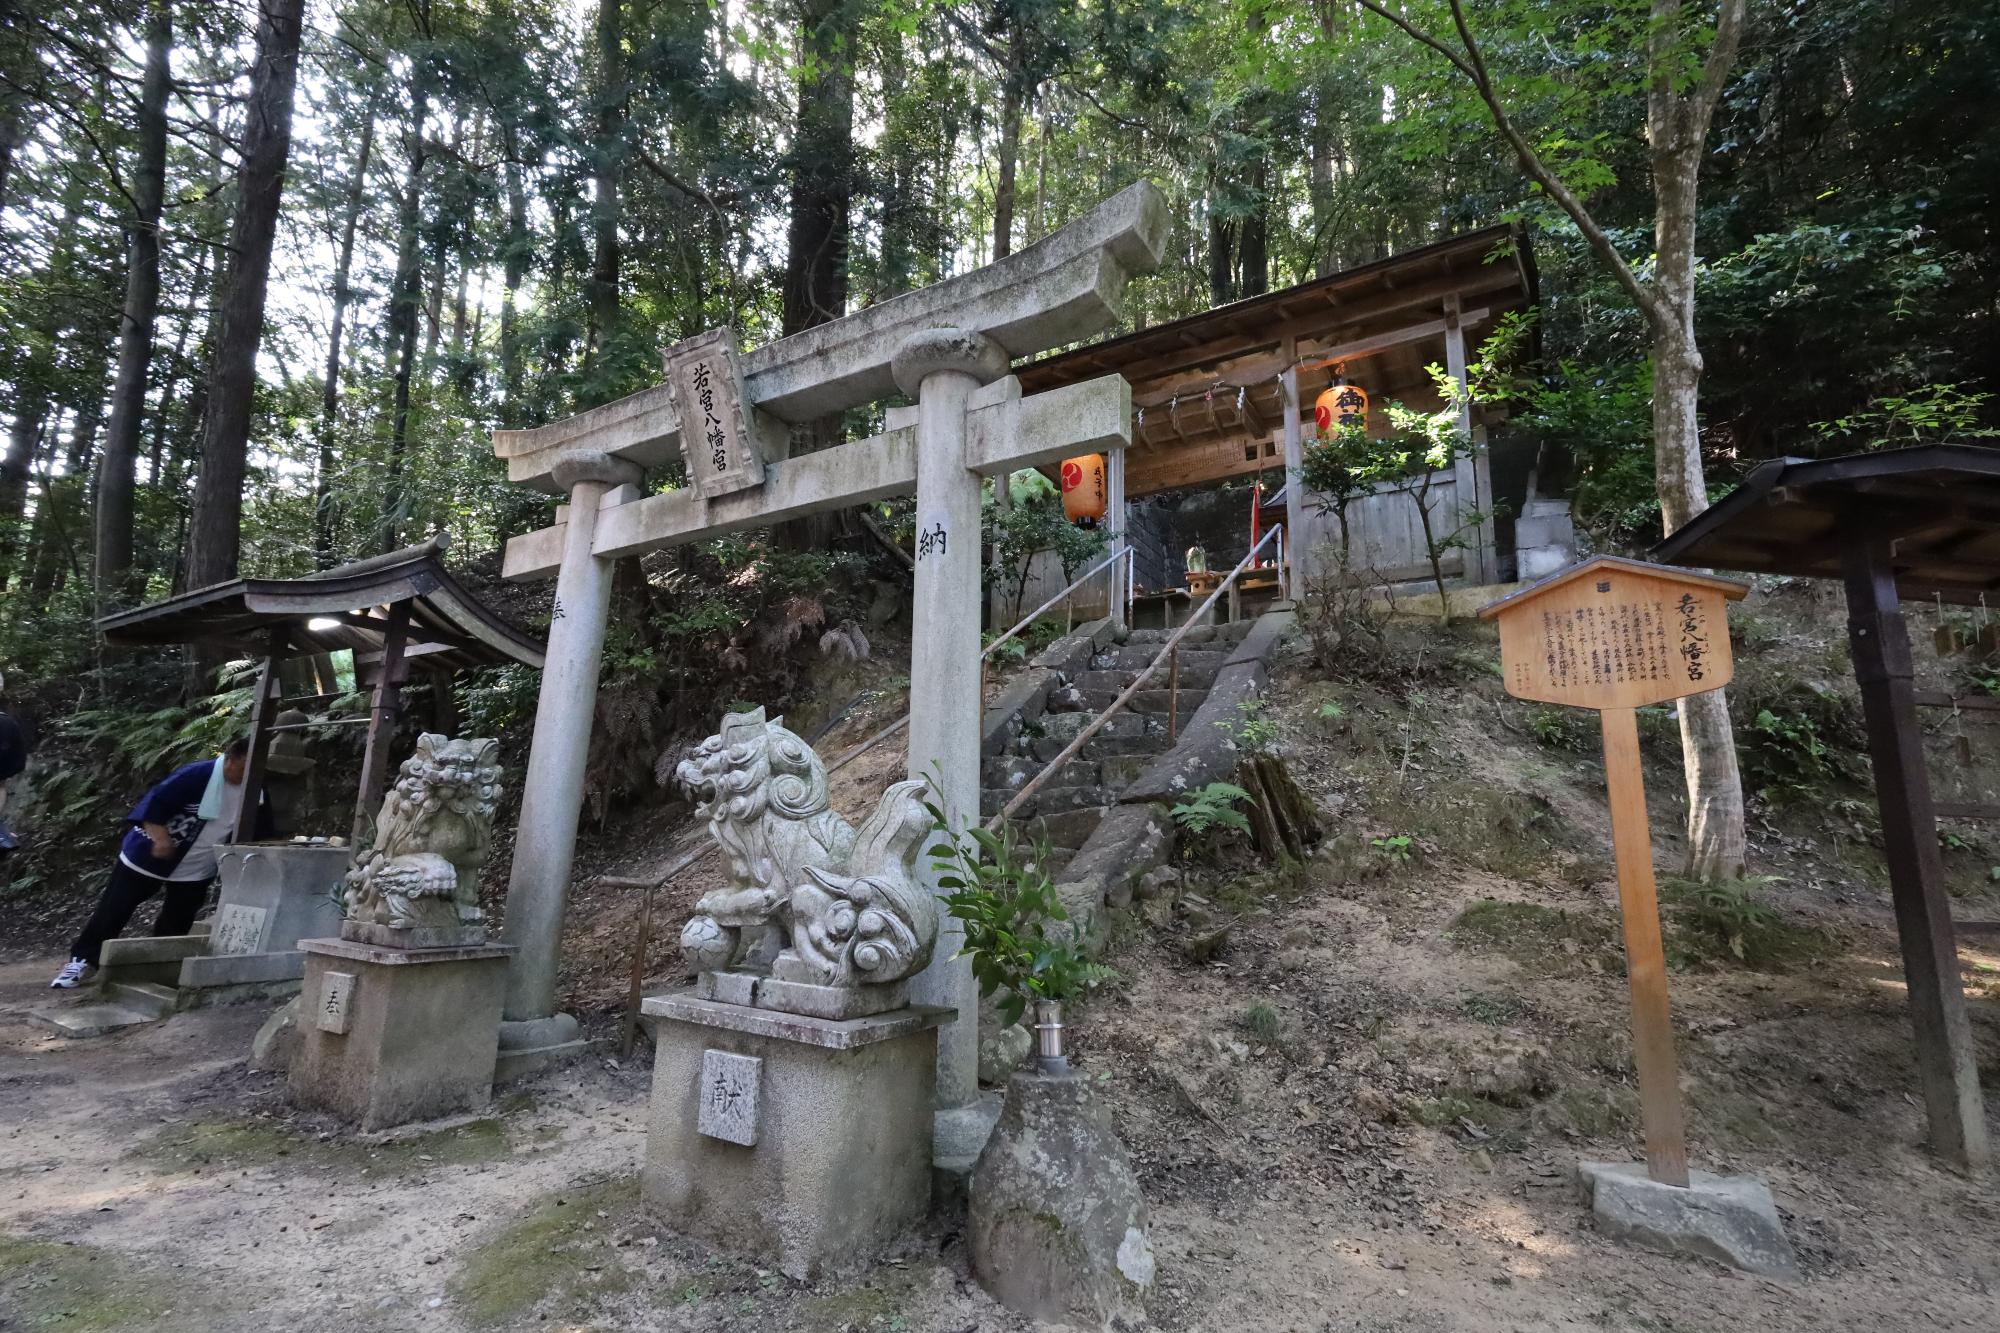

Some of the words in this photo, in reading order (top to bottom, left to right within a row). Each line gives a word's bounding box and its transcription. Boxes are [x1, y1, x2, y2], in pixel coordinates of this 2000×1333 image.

[692, 363, 727, 472] 若宮八幡宮
[920, 523, 947, 561] 納
[553, 596, 566, 624] 奉
[1674, 592, 1706, 682] 若宮八幡宮
[711, 1071, 743, 1120] 献
